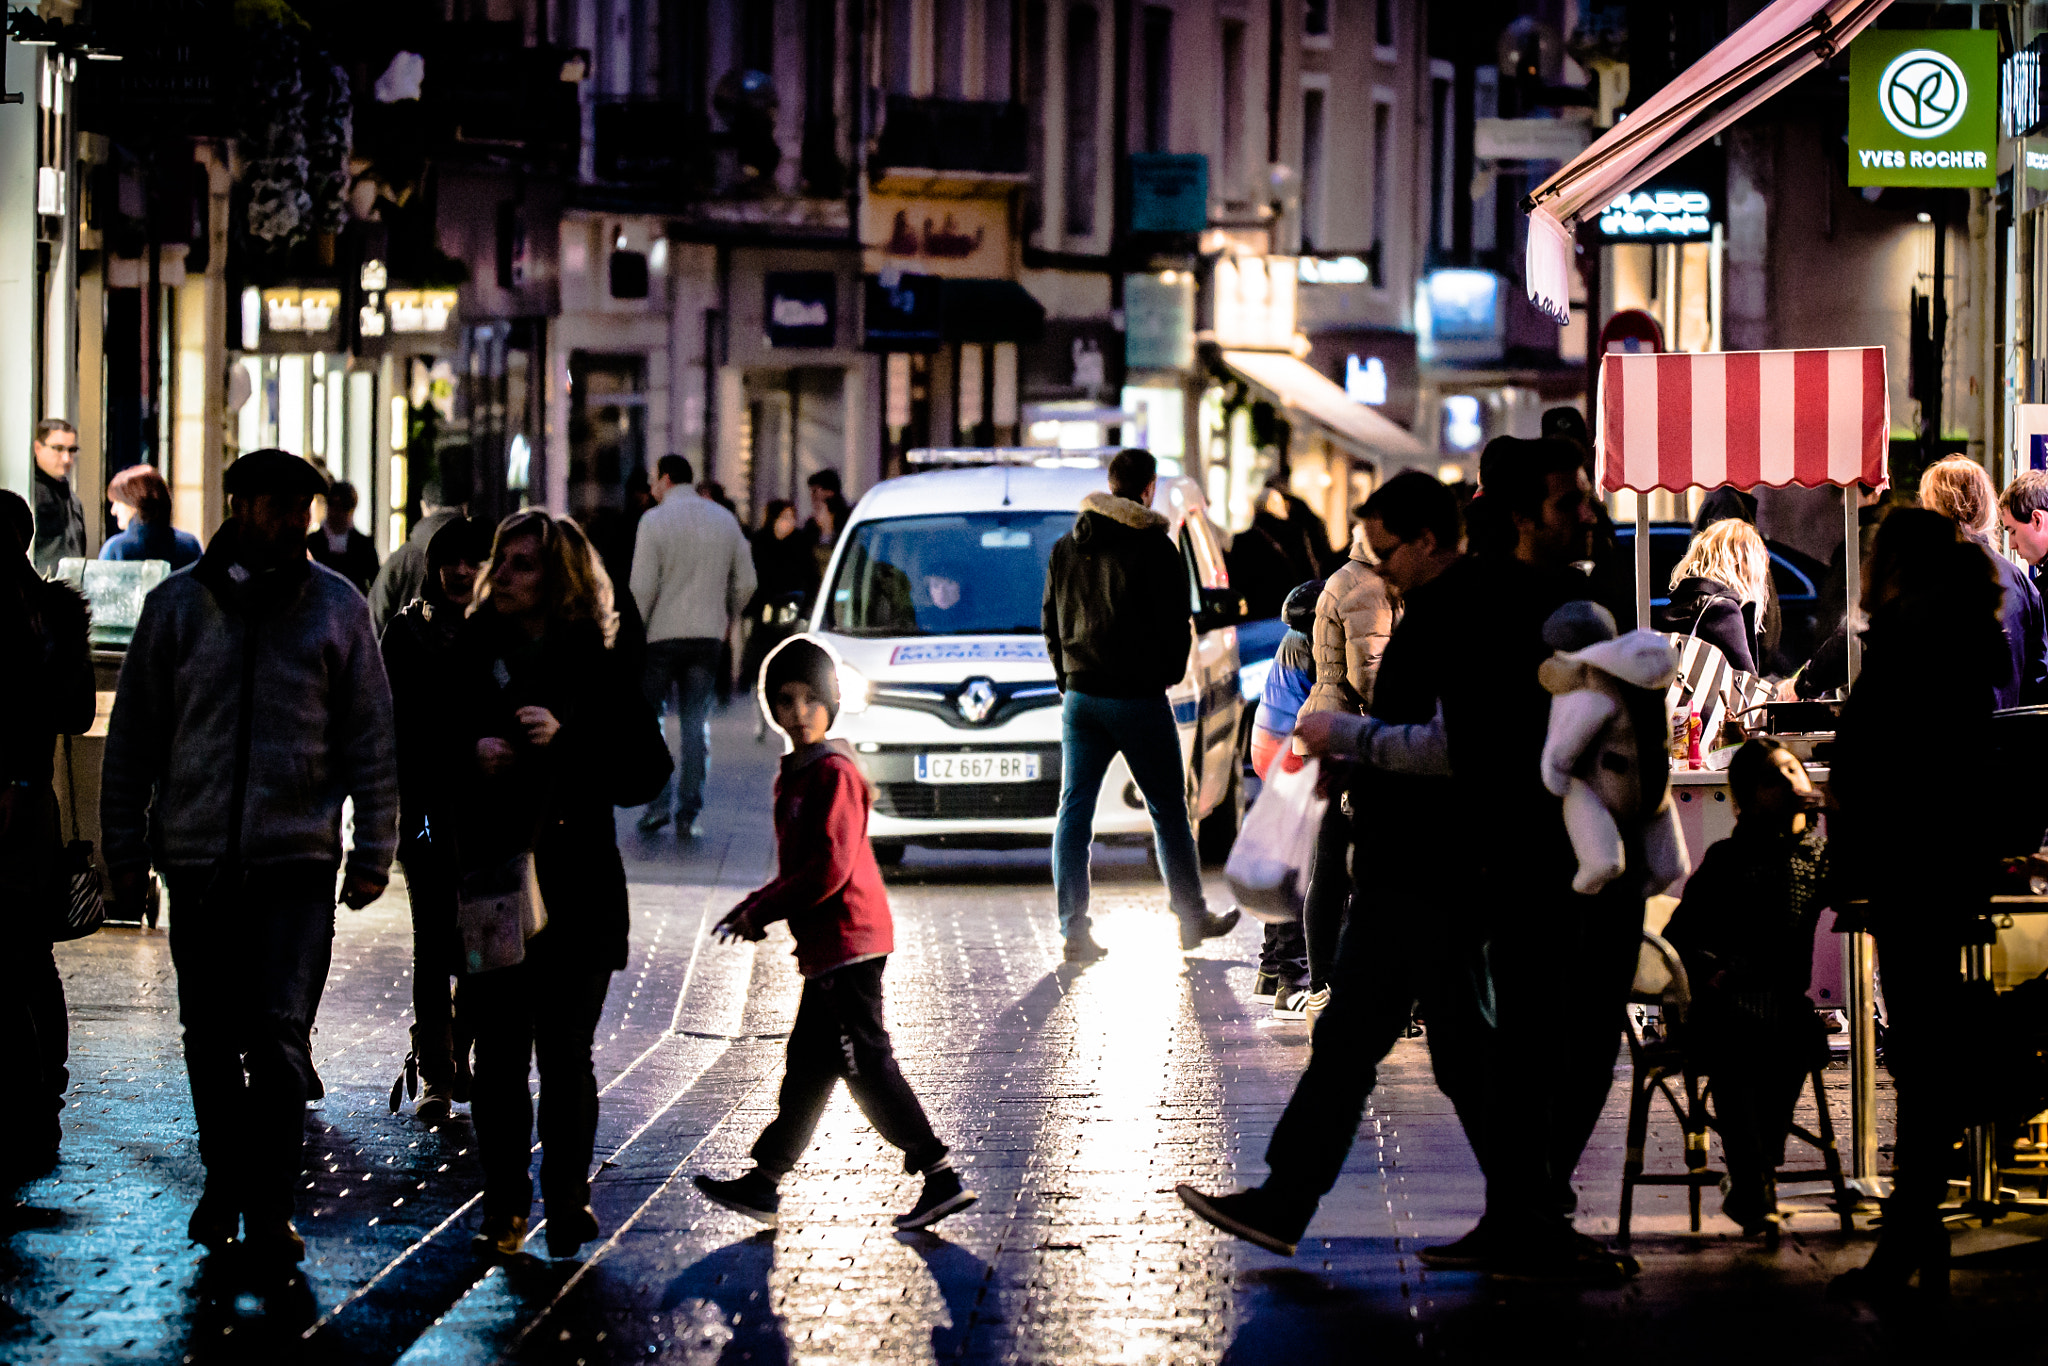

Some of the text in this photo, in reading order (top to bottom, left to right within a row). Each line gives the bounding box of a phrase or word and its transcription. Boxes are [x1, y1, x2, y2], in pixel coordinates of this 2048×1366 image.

[1858, 149, 1988, 170] YVES ROCHER
[899, 650, 1048, 661] MUNICIPAL
[932, 759, 953, 778] CZ
[960, 758, 994, 778] 667
[1000, 758, 1022, 777] BR
